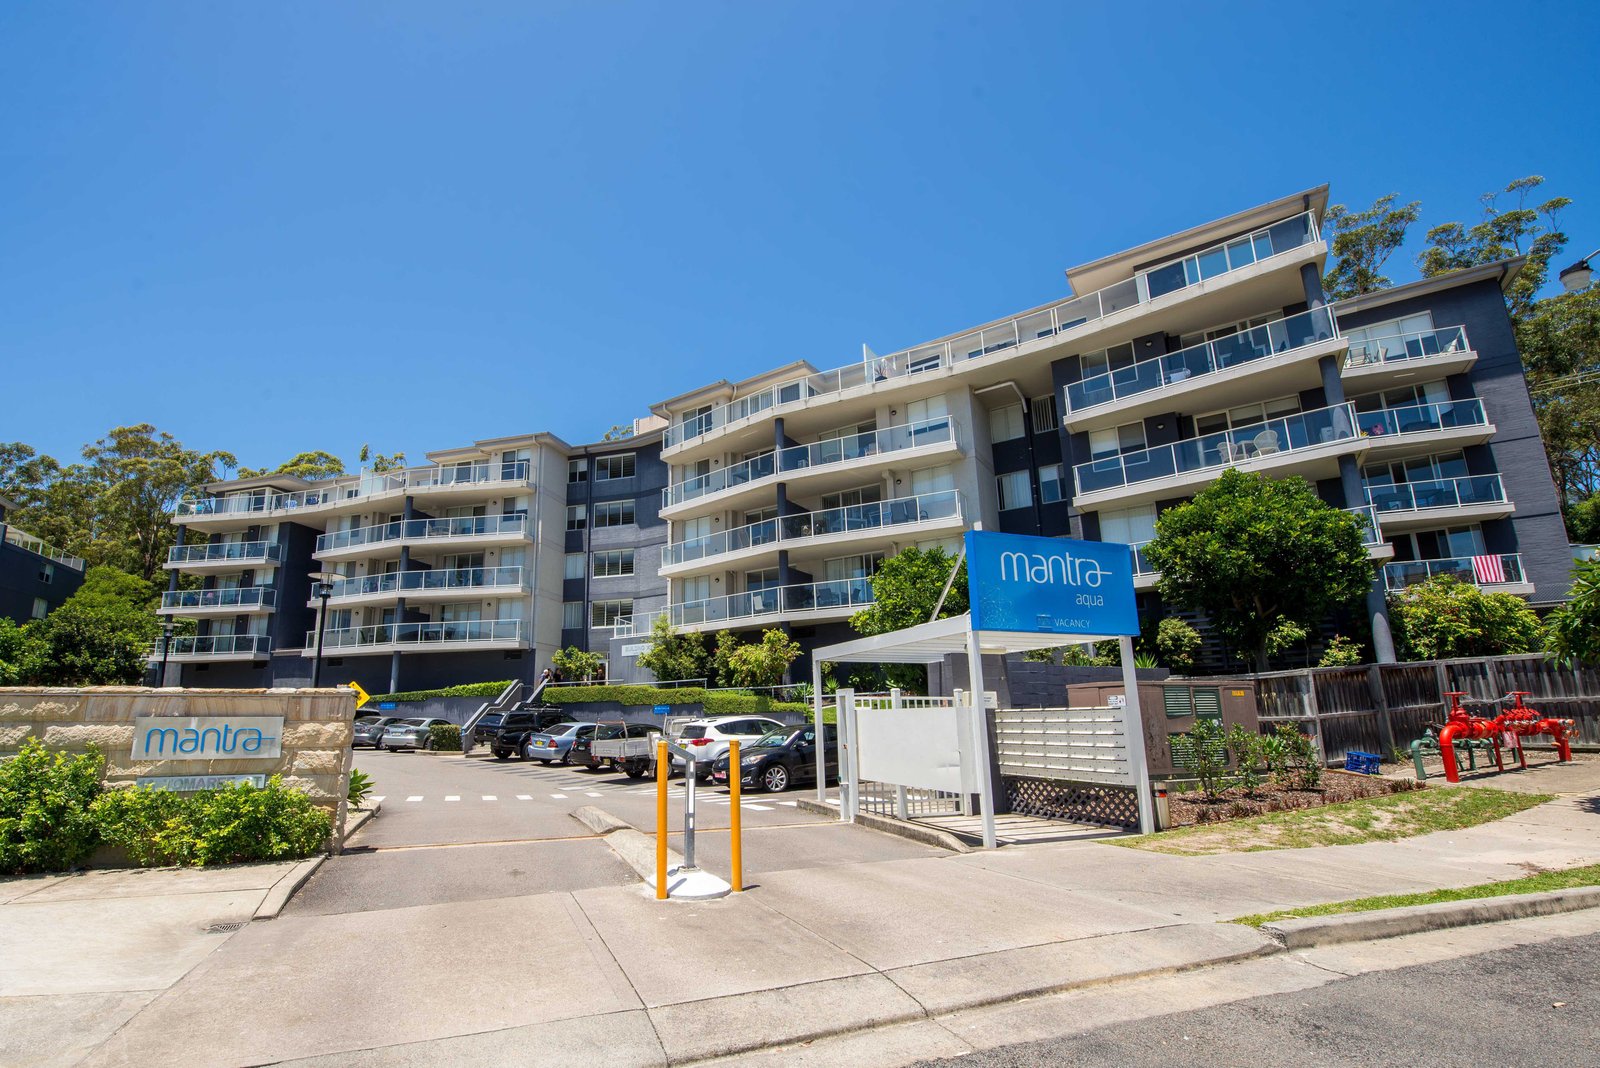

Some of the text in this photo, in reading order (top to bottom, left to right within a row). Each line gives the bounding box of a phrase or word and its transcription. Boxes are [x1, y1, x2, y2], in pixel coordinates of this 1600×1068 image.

[1000, 551, 1112, 588] mantra
[1076, 593, 1104, 608] aqua
[1054, 618, 1091, 629] VACANCY
[145, 724, 276, 753] mantra
